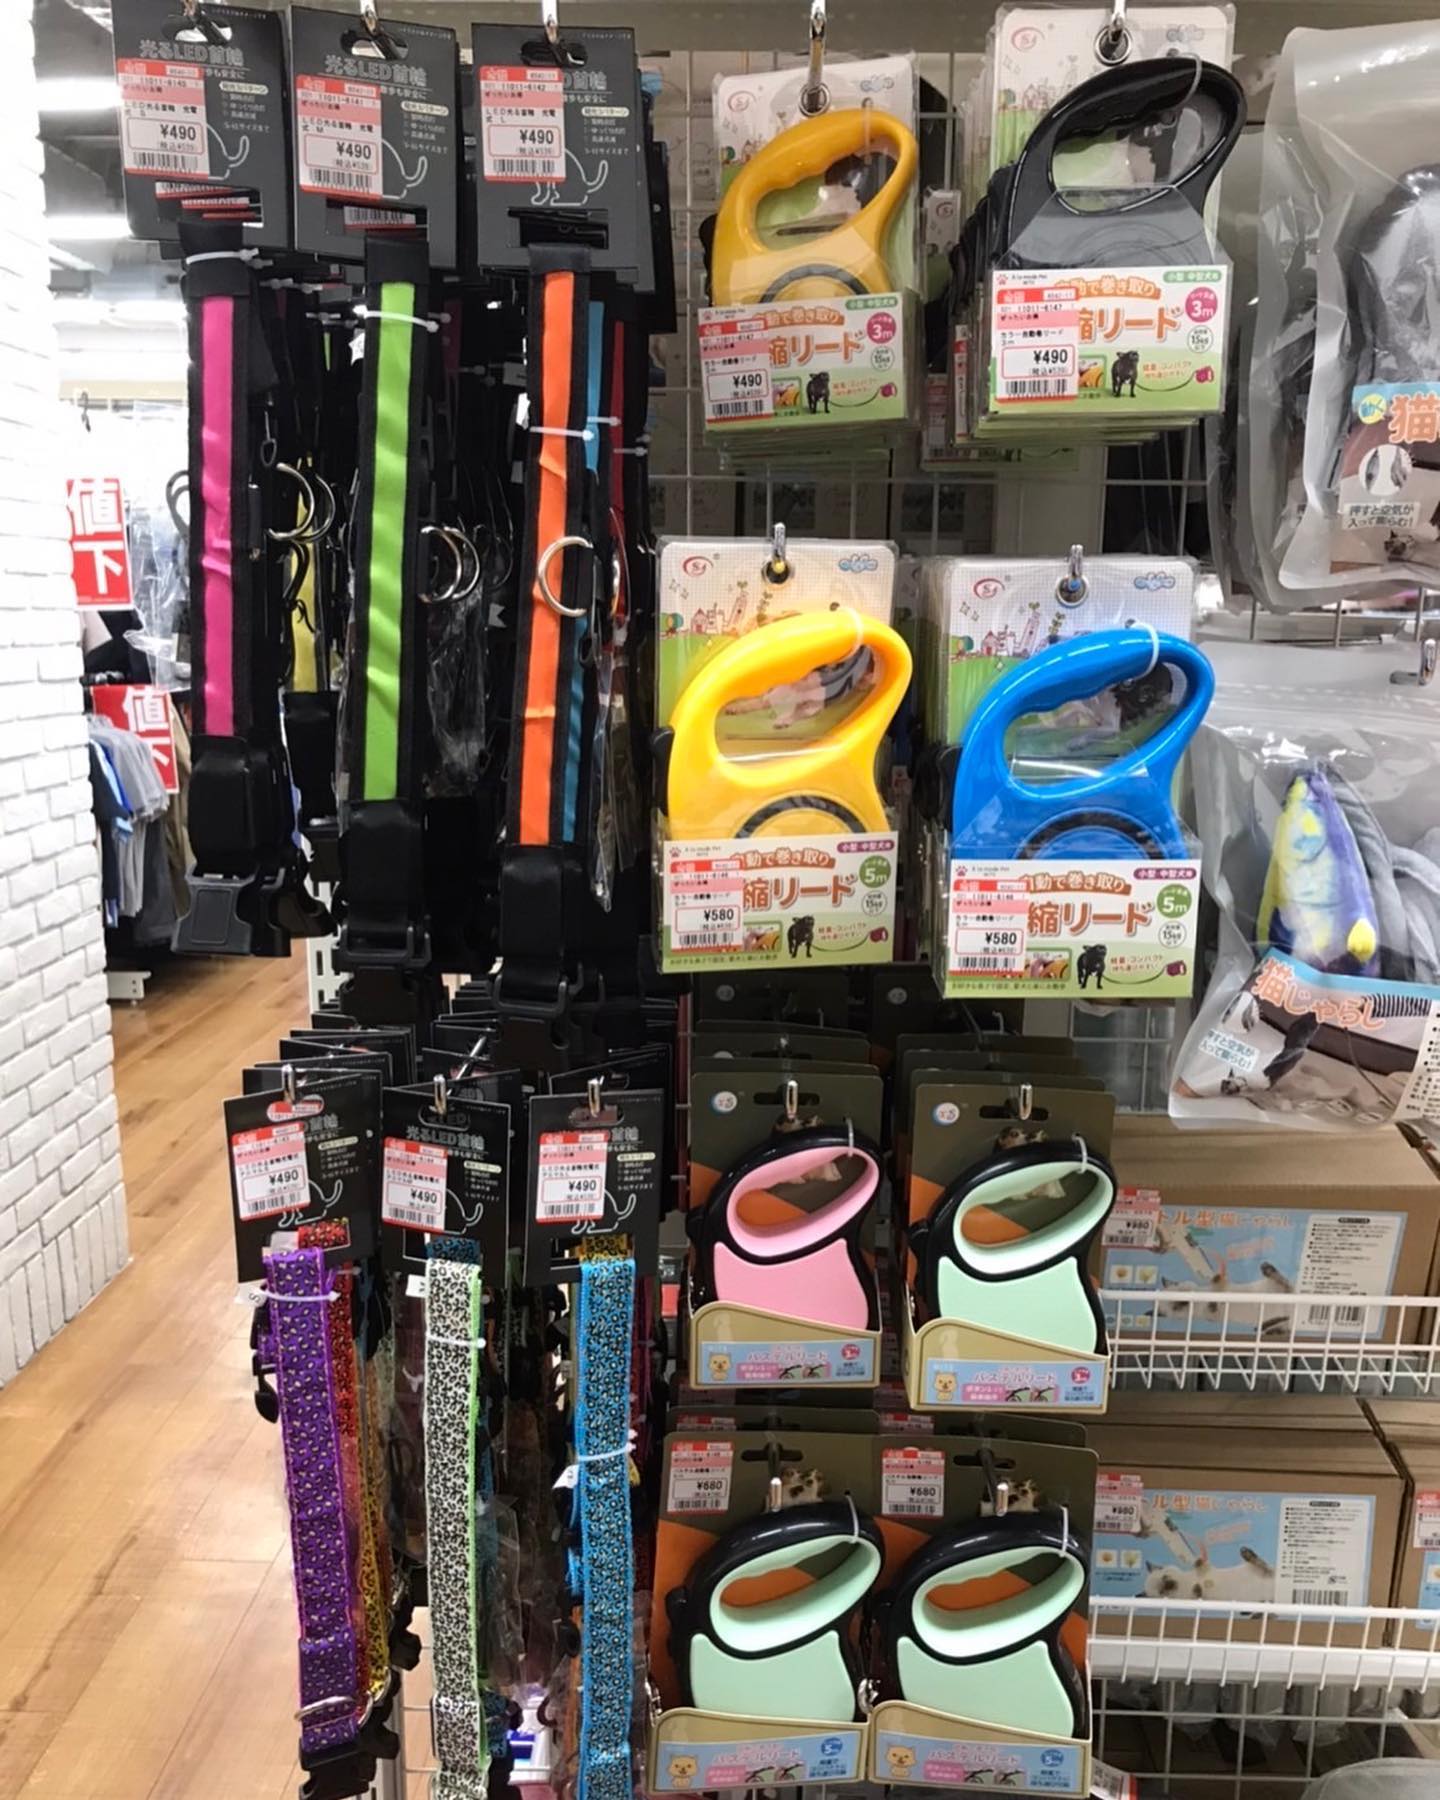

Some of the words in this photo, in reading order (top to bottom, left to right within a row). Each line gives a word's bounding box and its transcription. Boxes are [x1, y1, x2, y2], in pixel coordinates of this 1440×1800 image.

[140, 40, 243, 66] 光るLED首輪
[325, 54, 427, 87] 光るLED首輪
[160, 124, 196, 140] ¥490
[519, 129, 554, 145] ¥490
[336, 141, 371, 160] ¥490
[1191, 300, 1214, 317] 3m
[872, 324, 893, 338] 3m
[1033, 350, 1068, 365] ¥490
[733, 374, 762, 388] ¥490
[1389, 392, 1439, 443] 猫
[865, 869, 888, 883] 5m
[1163, 897, 1187, 912] 5m
[704, 909, 734, 921] ¥580
[985, 932, 1017, 945] ¥580
[1252, 958, 1387, 1030] 猫じゃらし
[269, 1170, 299, 1186] ¥490
[569, 1180, 596, 1192] ¥490
[411, 1189, 437, 1204] ¥490
[748, 1351, 828, 1362] パステルリード
[975, 1373, 1057, 1383] パステルリード
[910, 1487, 936, 1496] ¥680
[713, 1749, 800, 1764] パステルリード
[929, 1751, 1021, 1765] パステルリード
